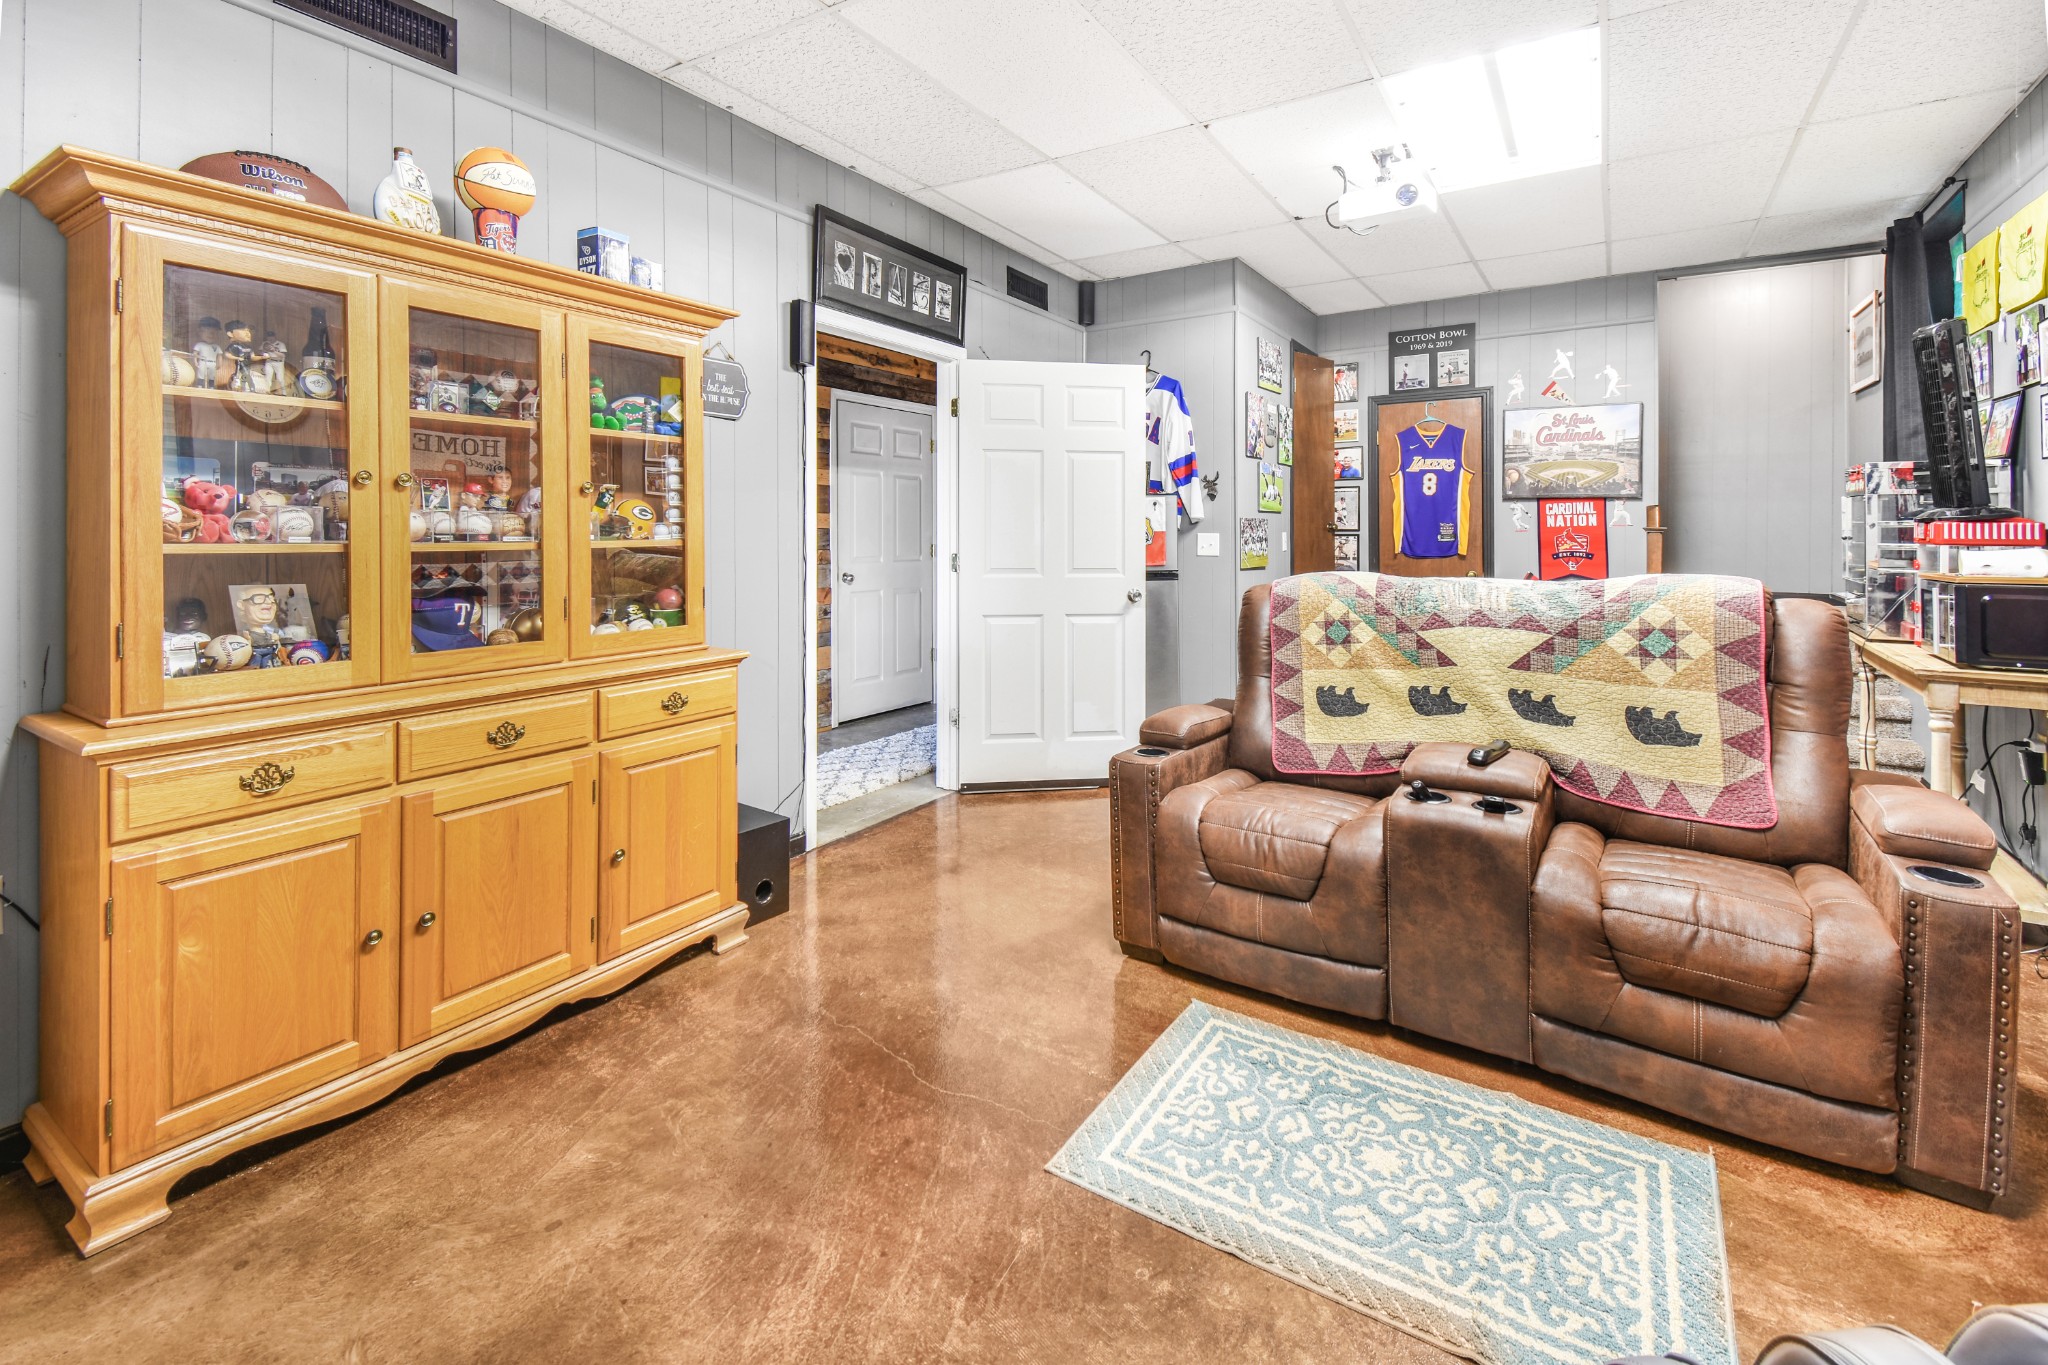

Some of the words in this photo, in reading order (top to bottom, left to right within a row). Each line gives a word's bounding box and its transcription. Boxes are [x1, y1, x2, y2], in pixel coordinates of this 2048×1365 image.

[240, 163, 306, 189] Wilson
[486, 223, 511, 234] Tigers
[579, 255, 596, 266] DYSON
[1395, 333, 1436, 344] COTTON
[1440, 329, 1468, 339] BOWL
[1410, 343, 1426, 351] 1969
[1436, 340, 1453, 348] 2019
[715, 373, 727, 382] THE
[708, 394, 719, 403] THE
[720, 396, 740, 406] HOUSE
[1565, 413, 1596, 428] Louis
[1536, 426, 1606, 446] Cardinals
[1406, 456, 1455, 472] LAKERS
[1423, 472, 1437, 496] 8
[1545, 501, 1597, 515] CARDINAL
[1546, 514, 1597, 528] NATION
